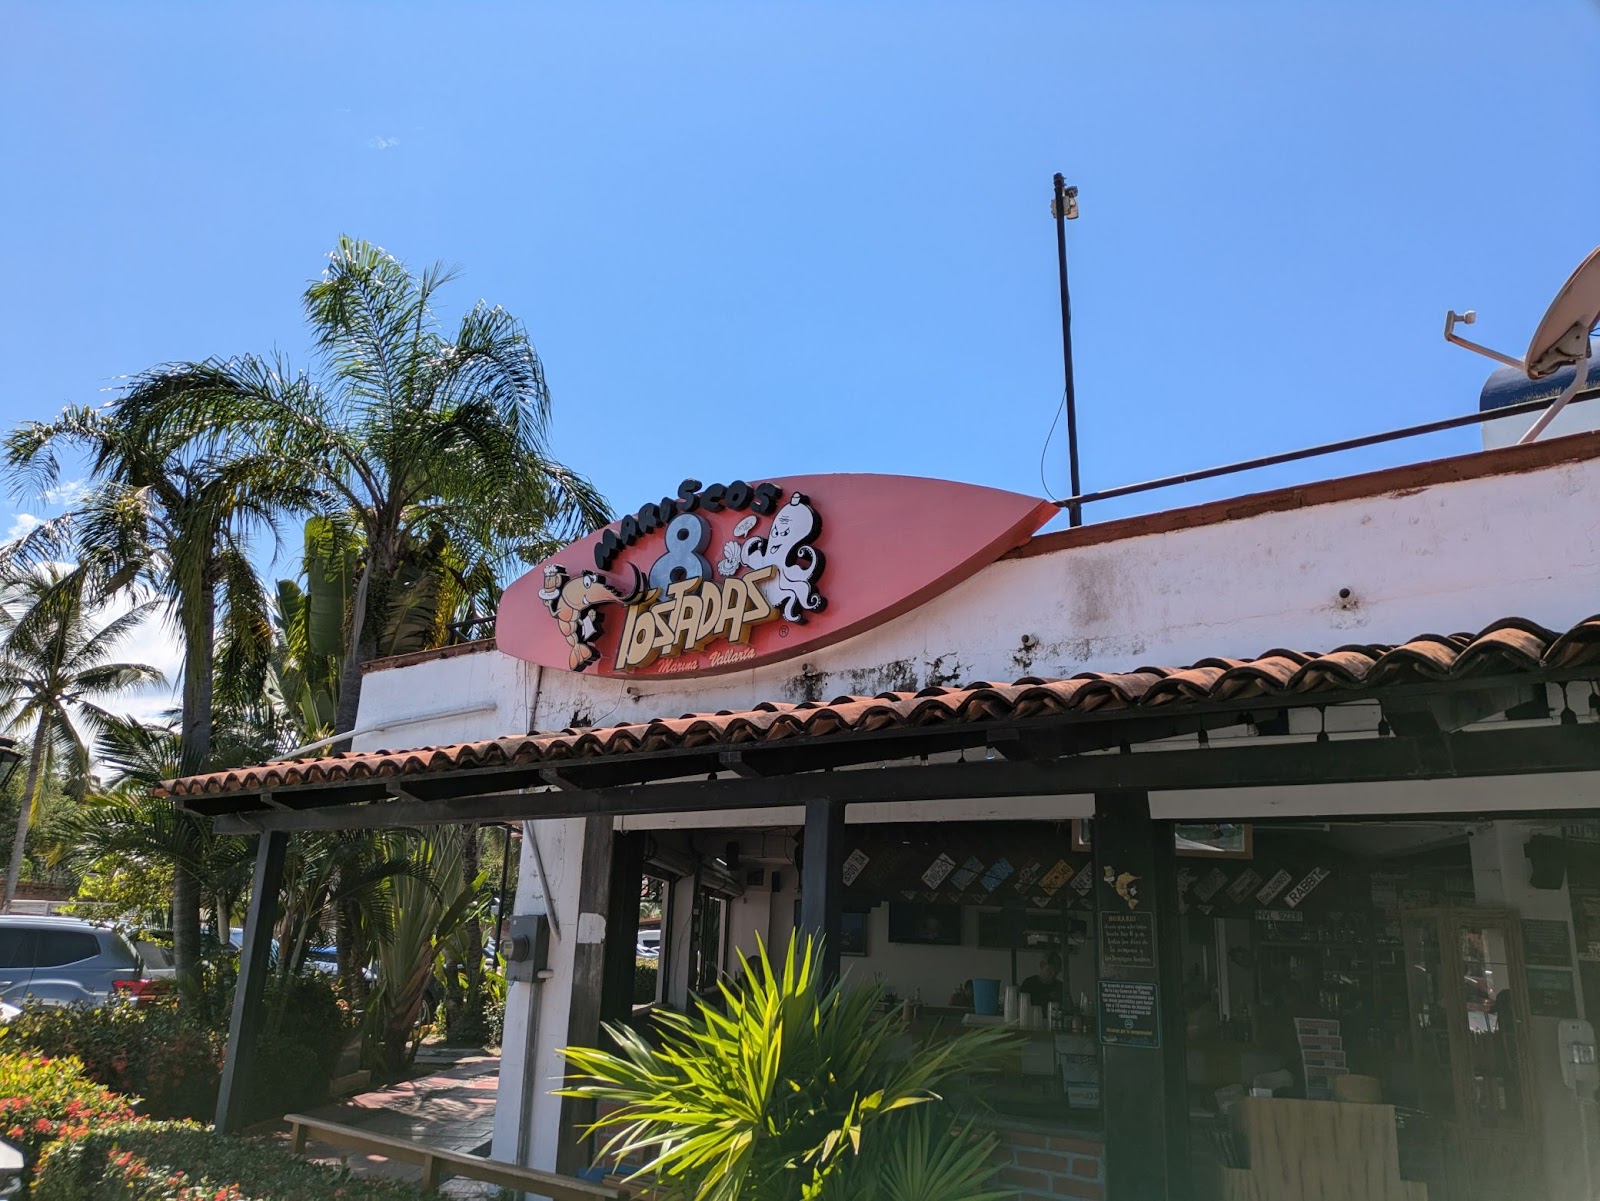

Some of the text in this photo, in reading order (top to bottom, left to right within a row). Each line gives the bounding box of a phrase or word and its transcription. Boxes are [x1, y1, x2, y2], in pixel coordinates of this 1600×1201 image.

[594, 478, 783, 571] MARISCOS
[649, 512, 712, 602] 8
[614, 564, 779, 670] TOSTADAS
[657, 647, 757, 673] Marina Vallarta
[1288, 869, 1322, 903] RABBIT
